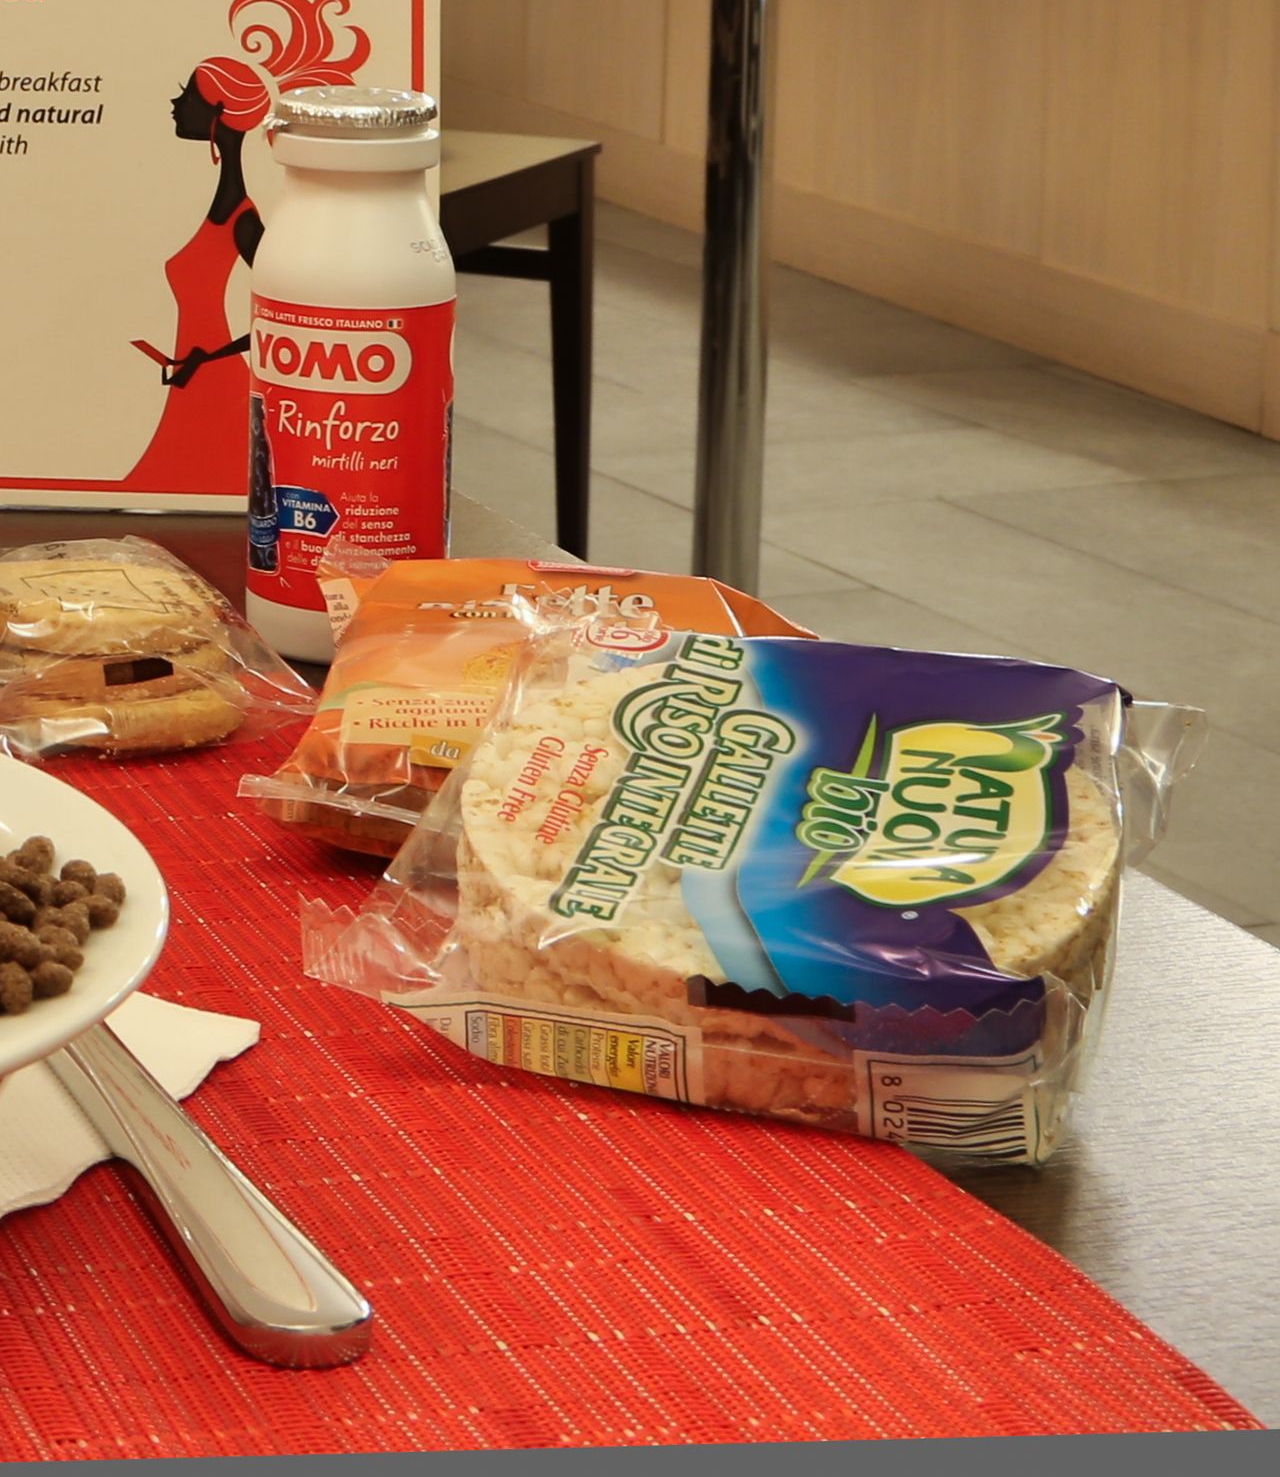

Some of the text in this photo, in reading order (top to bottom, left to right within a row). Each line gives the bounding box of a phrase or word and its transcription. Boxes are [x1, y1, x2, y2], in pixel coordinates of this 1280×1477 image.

[16, 104, 104, 124] natural
[275, 310, 296, 323] LATTE
[298, 314, 333, 327] FRESCO
[336, 319, 384, 330] ITALIANO
[255, 329, 395, 383] YOMO
[278, 400, 399, 450] Rinforzo
[312, 451, 398, 471] mirtilli neri
[282, 497, 331, 513] VITAMINA
[345, 505, 400, 516] riduzione
[293, 511, 317, 530] B6
[361, 521, 394, 530] senso
[350, 532, 411, 543] stanchezza
[688, 635, 743, 671] di
[369, 717, 439, 729] Ricche
[446, 717, 467, 728] in
[614, 664, 742, 759] RISO
[430, 741, 461, 760] da
[497, 736, 565, 823] Gluten Free
[661, 710, 795, 870] GALLETTE
[535, 744, 609, 845] Senza Glutine
[797, 767, 890, 853] bio
[550, 752, 691, 920] INTEGRALE
[658, 1042, 673, 1080] VALORI
